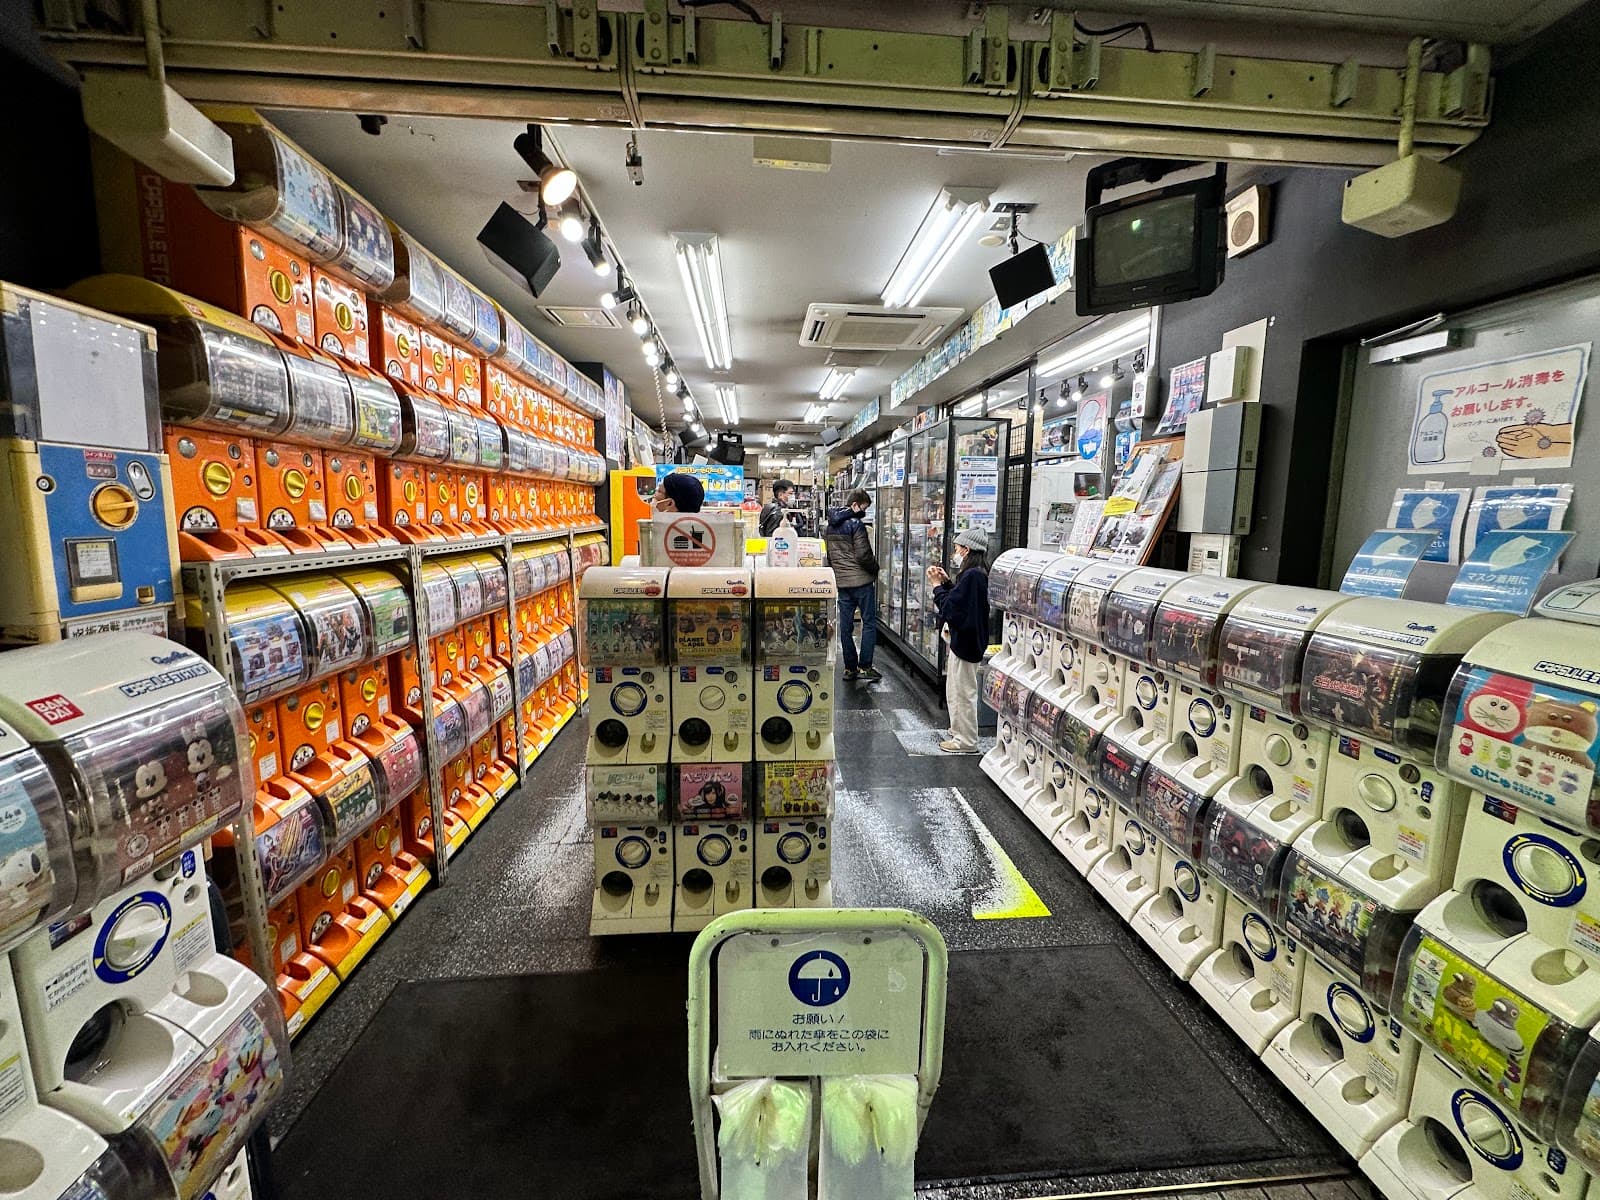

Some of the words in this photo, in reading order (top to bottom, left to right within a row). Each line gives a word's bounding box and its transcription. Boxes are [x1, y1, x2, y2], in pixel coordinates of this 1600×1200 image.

[1454, 370, 1566, 398] アルコール消毒を
[1451, 396, 1533, 418] お願いします。
[1355, 567, 1401, 577] マスク着用に
[1466, 572, 1529, 585] マスク着用に
[32, 696, 71, 712] BAN
[45, 708, 73, 722] DAI
[749, 1029, 889, 1040] 雨にぬれた傘をこの袋に
[771, 1042, 866, 1053] お入れください。
